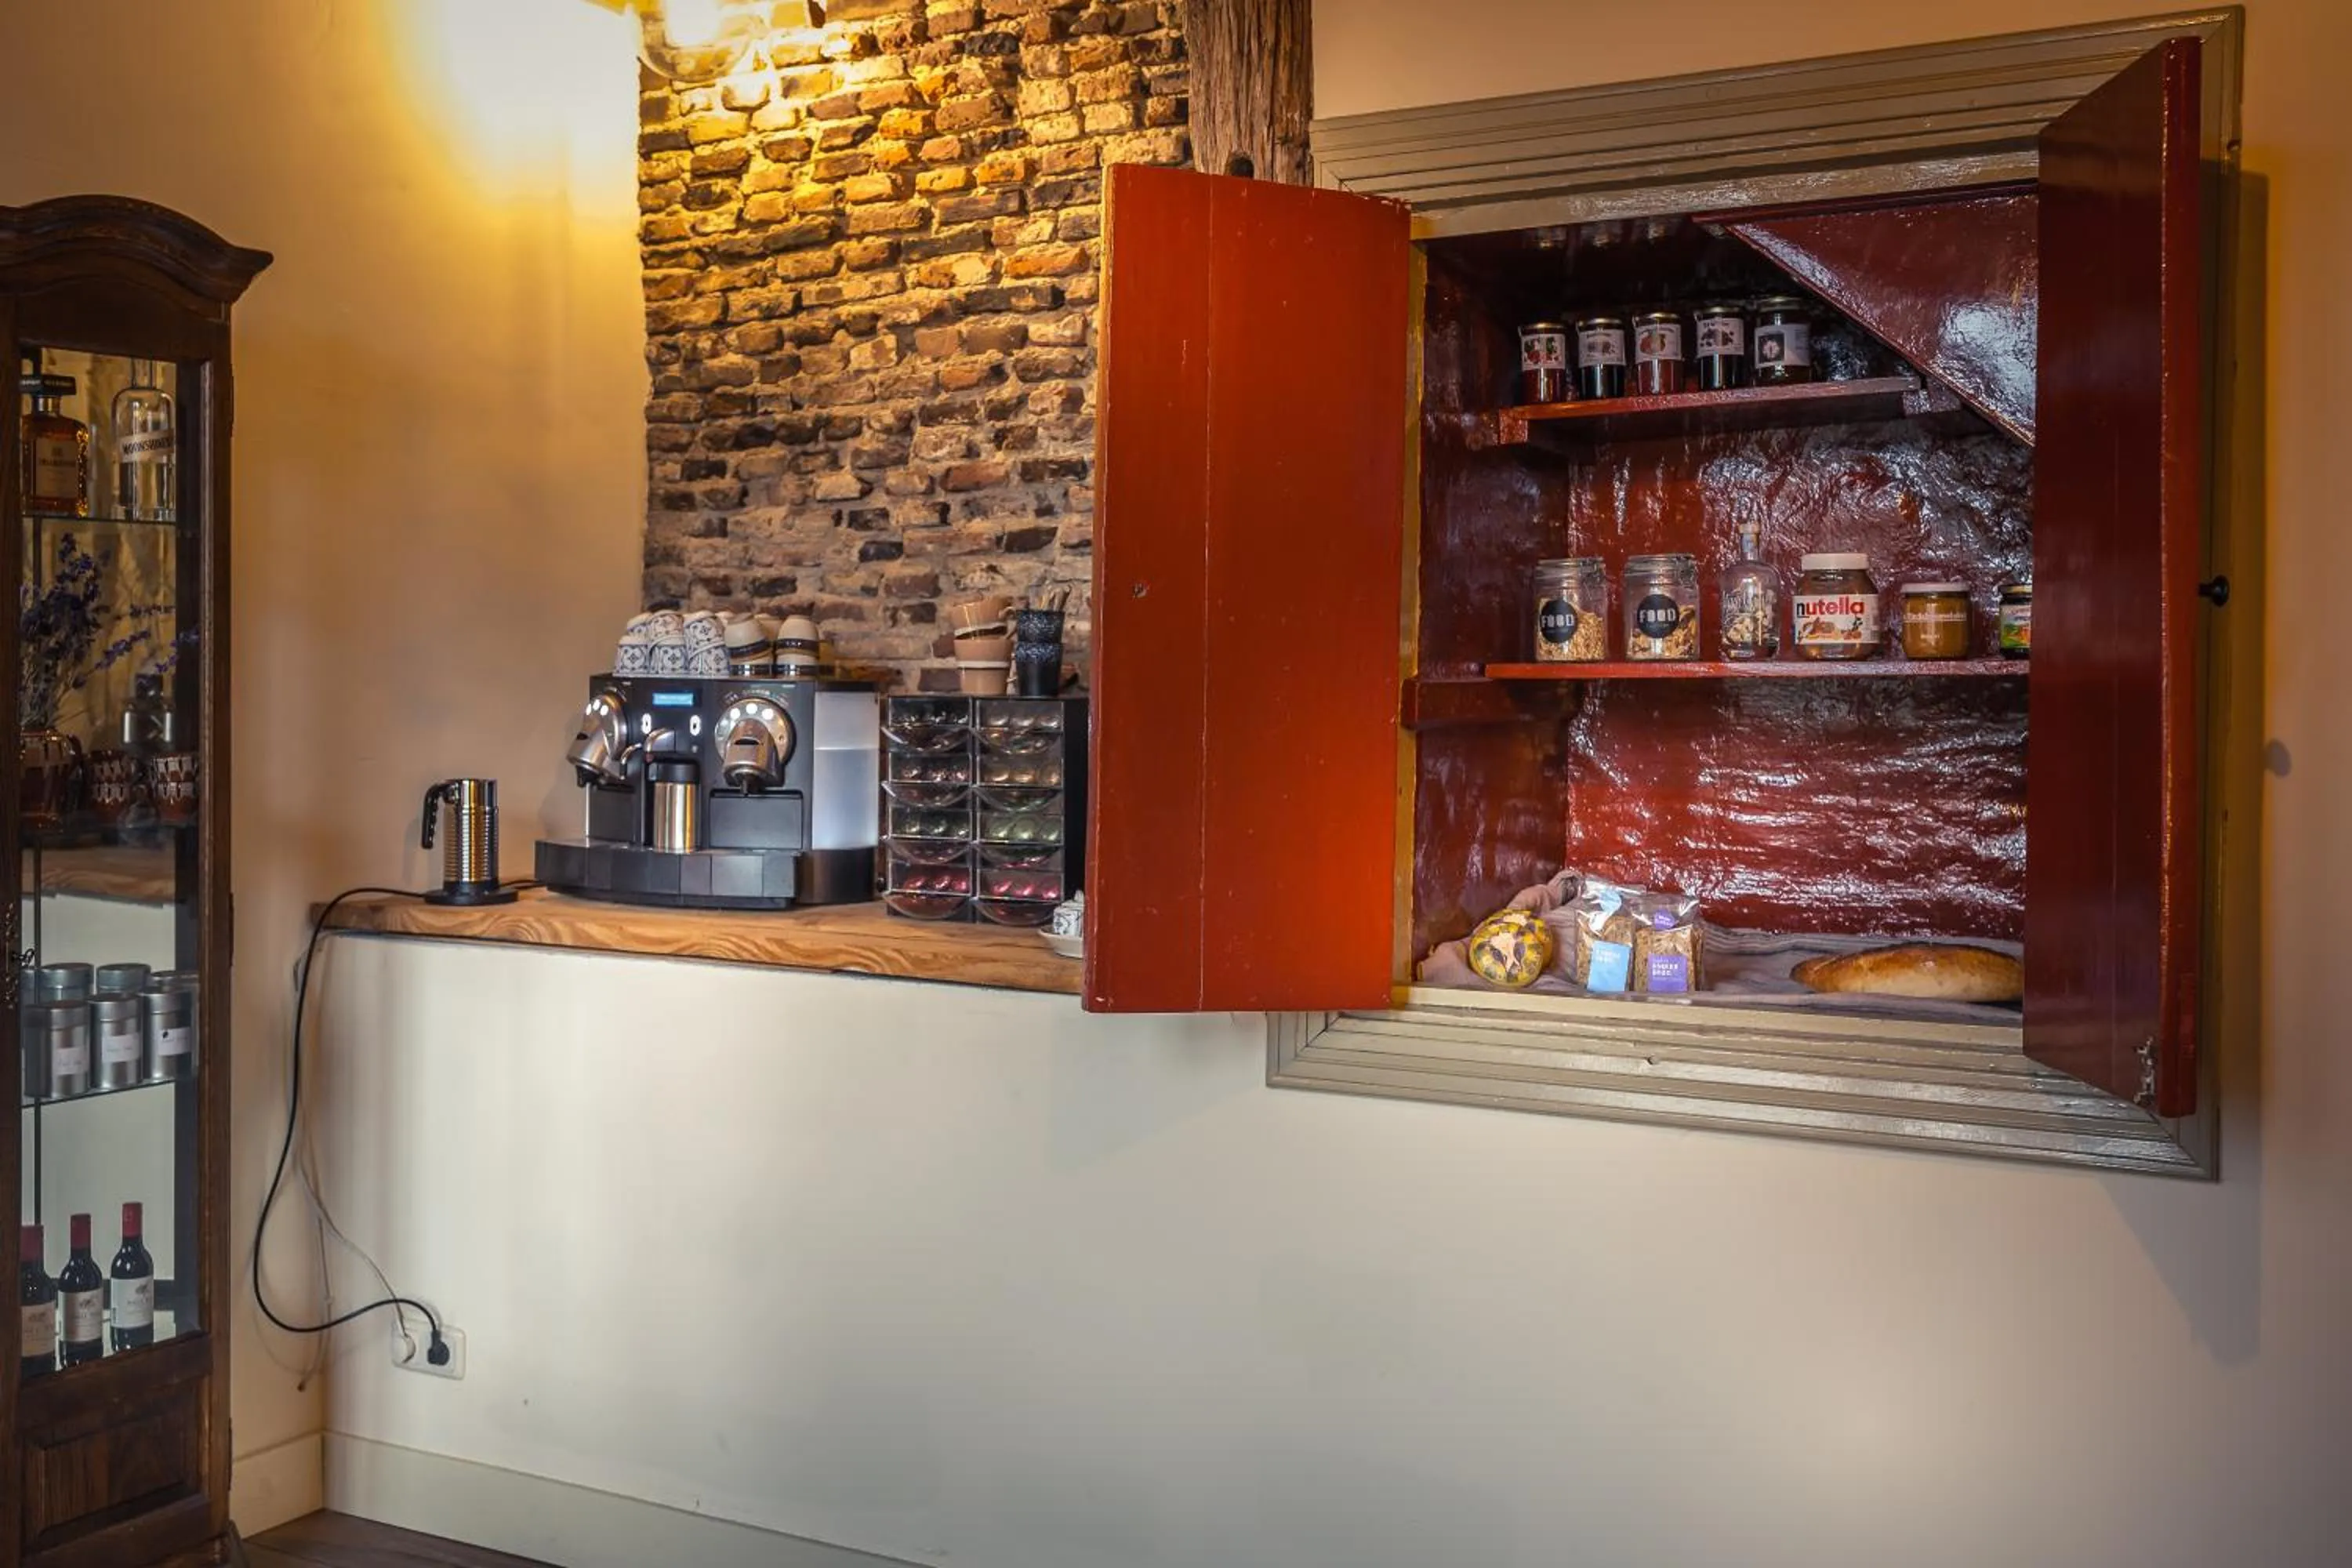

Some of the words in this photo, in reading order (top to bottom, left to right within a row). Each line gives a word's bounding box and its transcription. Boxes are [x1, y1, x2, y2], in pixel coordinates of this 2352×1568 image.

[1796, 596, 1864, 616] nutella
[1541, 614, 1574, 628] FOOD
[1639, 608, 1676, 622] FOOD
